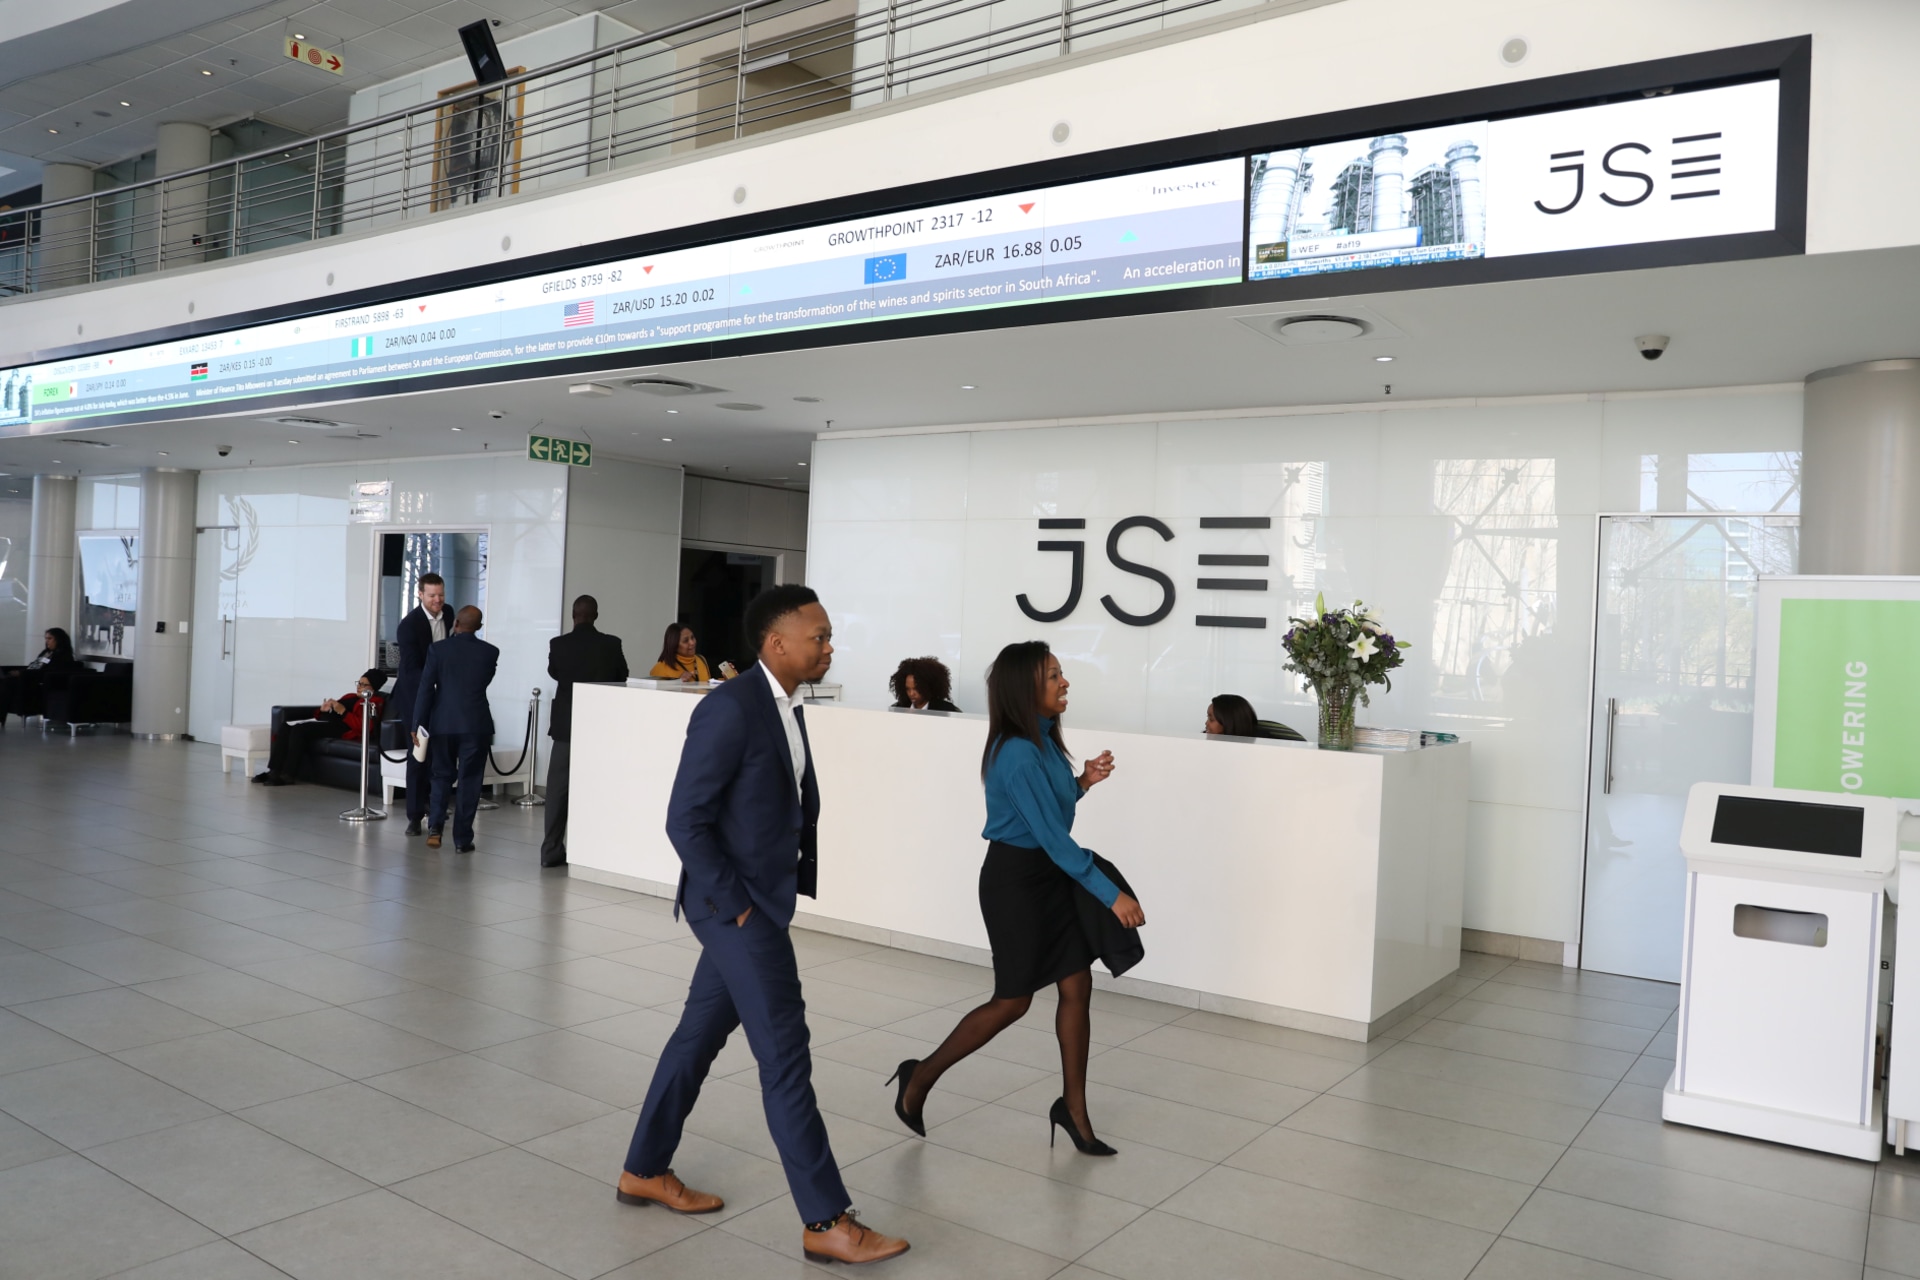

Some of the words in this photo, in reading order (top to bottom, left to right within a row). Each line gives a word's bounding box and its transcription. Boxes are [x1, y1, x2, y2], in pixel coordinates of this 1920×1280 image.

[1152, 179, 1220, 195] Investec
[1534, 132, 1722, 215] JSE
[828, 219, 924, 247] GROWTHPOINT
[931, 213, 964, 231] 2317
[971, 208, 993, 223] -12
[935, 247, 995, 269] ZAR/EUR
[1003, 241, 1042, 260] 16.88
[1050, 236, 1082, 253] 0.05
[1123, 266, 1141, 280] An
[1145, 256, 1224, 278] acceleration
[1228, 254, 1242, 268] in
[542, 277, 577, 294] GFIELDS
[581, 273, 603, 288] 8759
[608, 269, 623, 283] -82
[613, 297, 655, 314] ZAR/USD
[660, 292, 688, 308] 15.20
[692, 288, 715, 303] 0.02
[273, 377, 292, 387] Tuesday
[325, 369, 352, 381] agreement
[352, 368, 358, 376] to
[359, 364, 388, 375] Parliament
[388, 361, 412, 372] between
[412, 359, 420, 368] SA
[421, 357, 432, 367] and
[433, 355, 444, 365] the
[444, 352, 473, 364] European
[474, 347, 514, 361] Commission,
[515, 344, 524, 355] for
[526, 343, 537, 354] the
[538, 341, 556, 352] latter
[558, 340, 565, 350] to
[567, 335, 594, 350] provide
[595, 333, 616, 345] €10m
[617, 328, 648, 342] towards
[650, 329, 655, 338] a
[656, 322, 691, 337] "support
[693, 317, 742, 334] programme
[744, 314, 756, 326] for
[758, 312, 773, 324] the
[776, 302, 844, 321] transformation
[846, 300, 858, 312] of
[859, 298, 876, 311] the
[879, 294, 908, 308] wines
[910, 290, 930, 304] and
[933, 288, 966, 303] spirits
[968, 284, 1003, 298] sector
[1005, 281, 1016, 294] in
[1019, 276, 1053, 292] South
[1056, 269, 1100, 288] Africa".
[335, 313, 370, 328] FIRSTRAND
[385, 334, 418, 349] ZAR/NGN
[421, 331, 437, 343] 0.04
[439, 328, 456, 341] 0.00
[1016, 515, 1271, 628] JSE
[1841, 660, 1867, 791] OWERING
